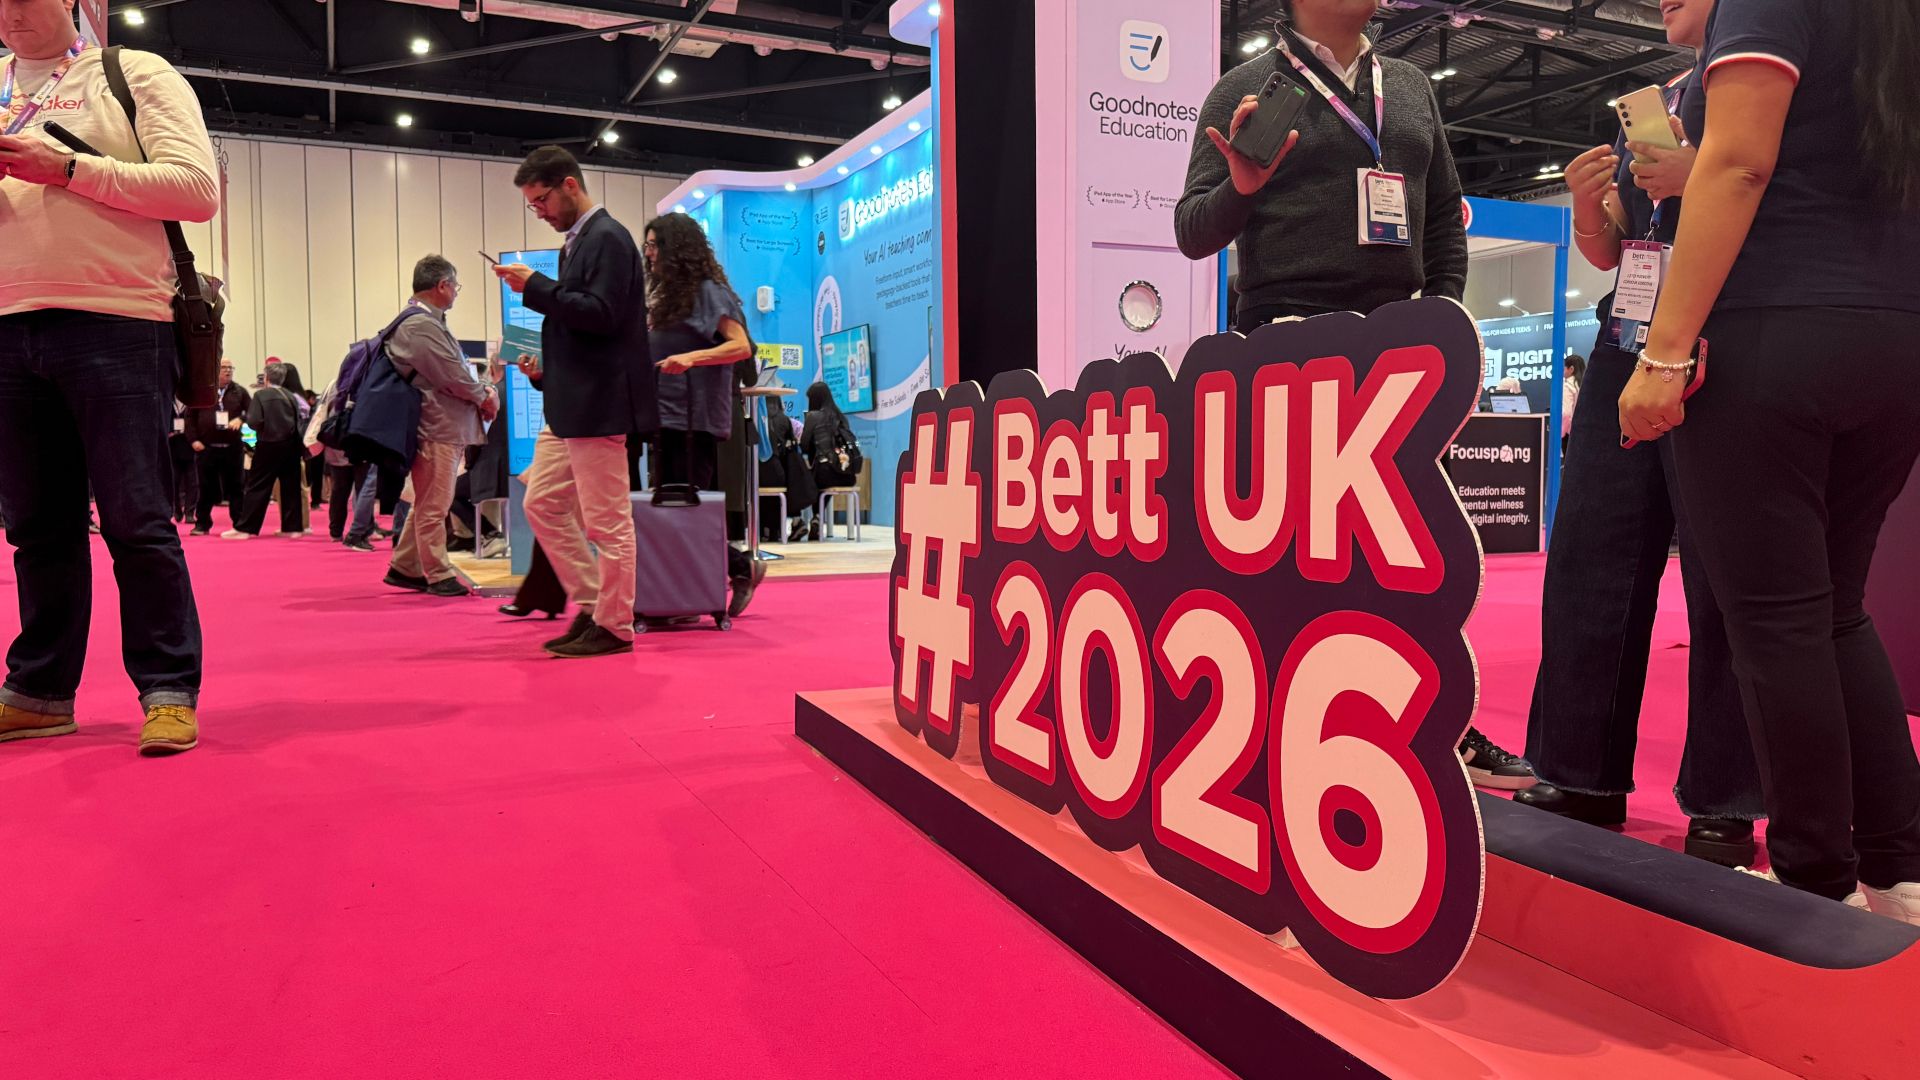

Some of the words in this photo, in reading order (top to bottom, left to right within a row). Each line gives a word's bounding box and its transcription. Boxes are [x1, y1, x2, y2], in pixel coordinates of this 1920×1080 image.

[1089, 91, 1198, 122] Goodnotes
[1100, 116, 1188, 142] Education
[854, 178, 914, 225] Goodnotes
[863, 247, 877, 267] Your
[878, 241, 885, 261] AI
[886, 234, 915, 259] teaching
[1515, 325, 1531, 333] TEENS
[997, 403, 1161, 545] Bett
[1202, 369, 1428, 569] UK
[1458, 485, 1500, 497] Education
[1501, 486, 1526, 496] meets
[1490, 499, 1524, 510] wellness
[1470, 513, 1495, 526] digital
[1496, 513, 1530, 525] integrity.
[993, 574, 1430, 930] 2026
